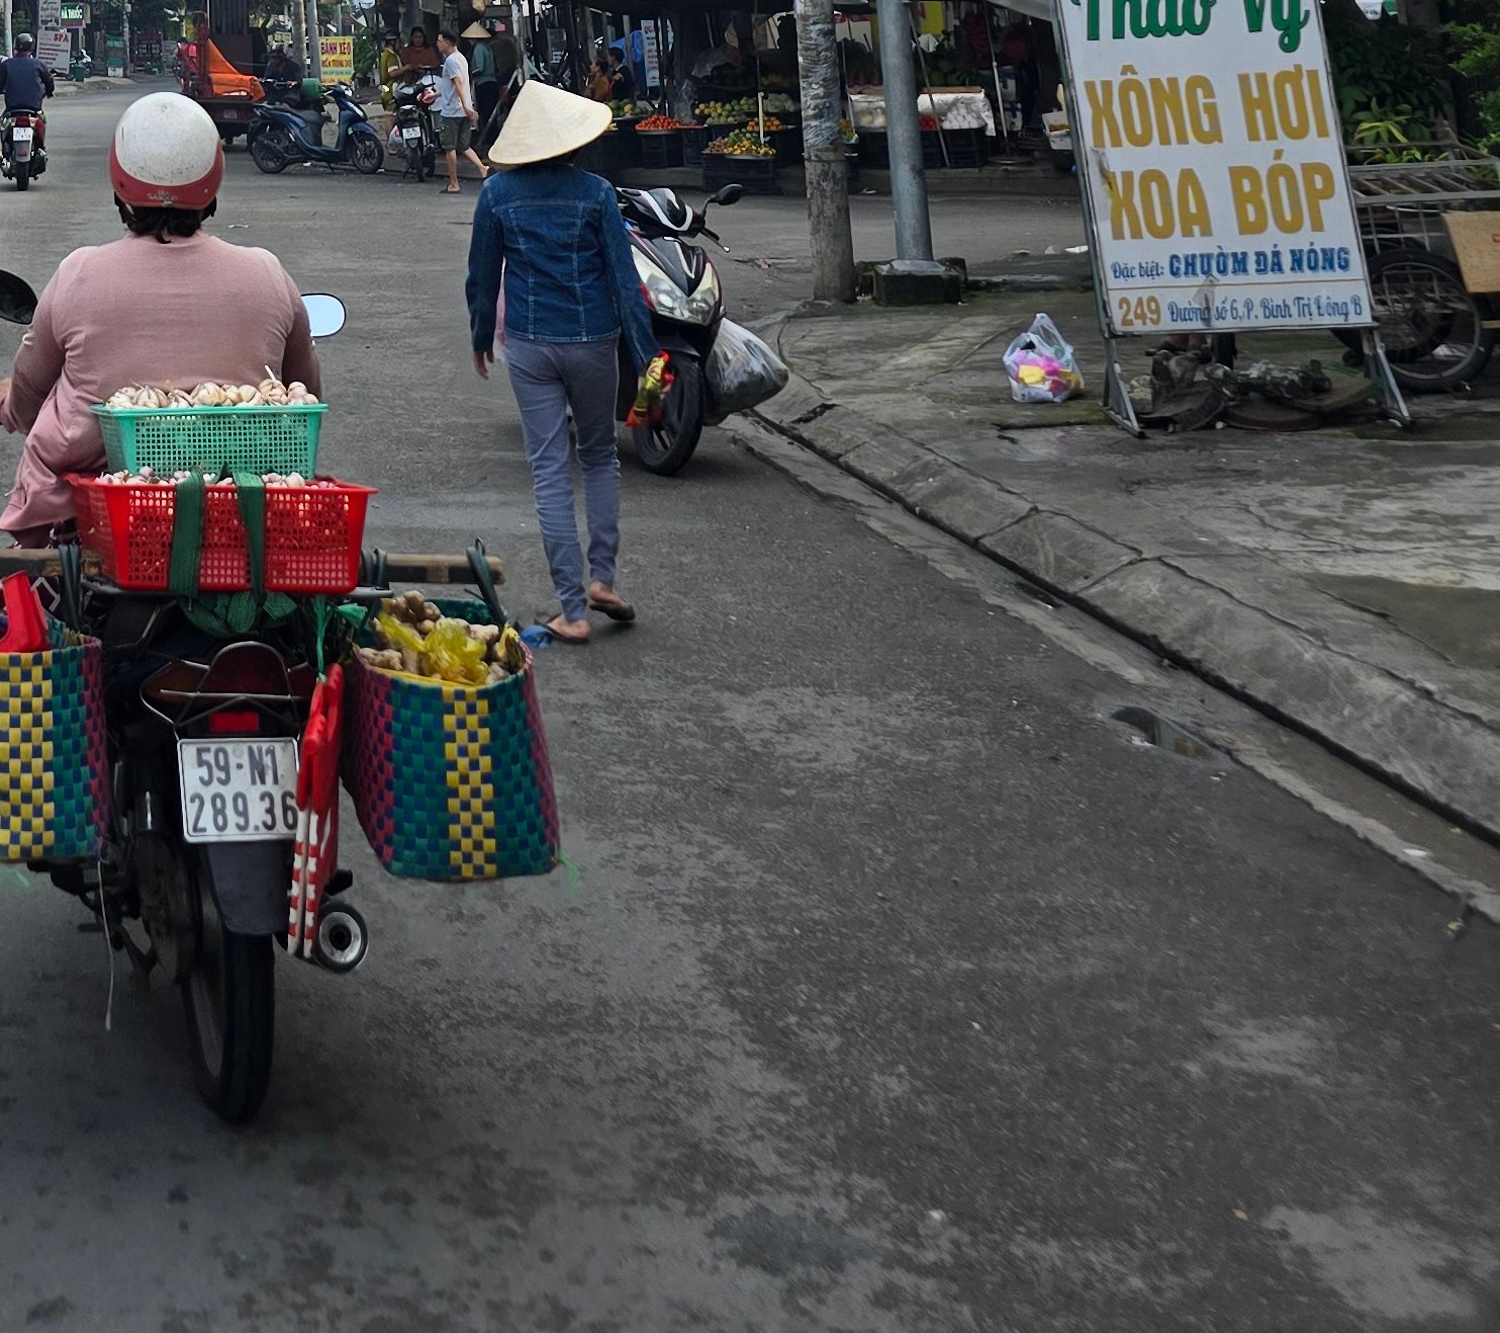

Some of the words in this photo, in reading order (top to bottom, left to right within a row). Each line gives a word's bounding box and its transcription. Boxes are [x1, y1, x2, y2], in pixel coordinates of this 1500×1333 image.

[1084, 64, 1223, 149] XÔNG
[1238, 63, 1330, 142] HƠI
[1108, 168, 1212, 241] XOA
[1229, 150, 1335, 236] BÓP
[1111, 262, 1137, 282] Đặc
[1139, 260, 1164, 280] biệt:
[1168, 245, 1249, 278] CHƯỜM
[1254, 244, 1284, 275] ĐÁ
[1289, 242, 1350, 273] NÓNG
[1118, 295, 1161, 327] 249
[1214, 296, 1228, 321] số
[1260, 297, 1292, 320] Bình
[1292, 296, 1314, 322] Trị
[1350, 294, 1363, 317] B
[195, 744, 279, 787] 59-N1
[189, 790, 298, 834] 289.36
